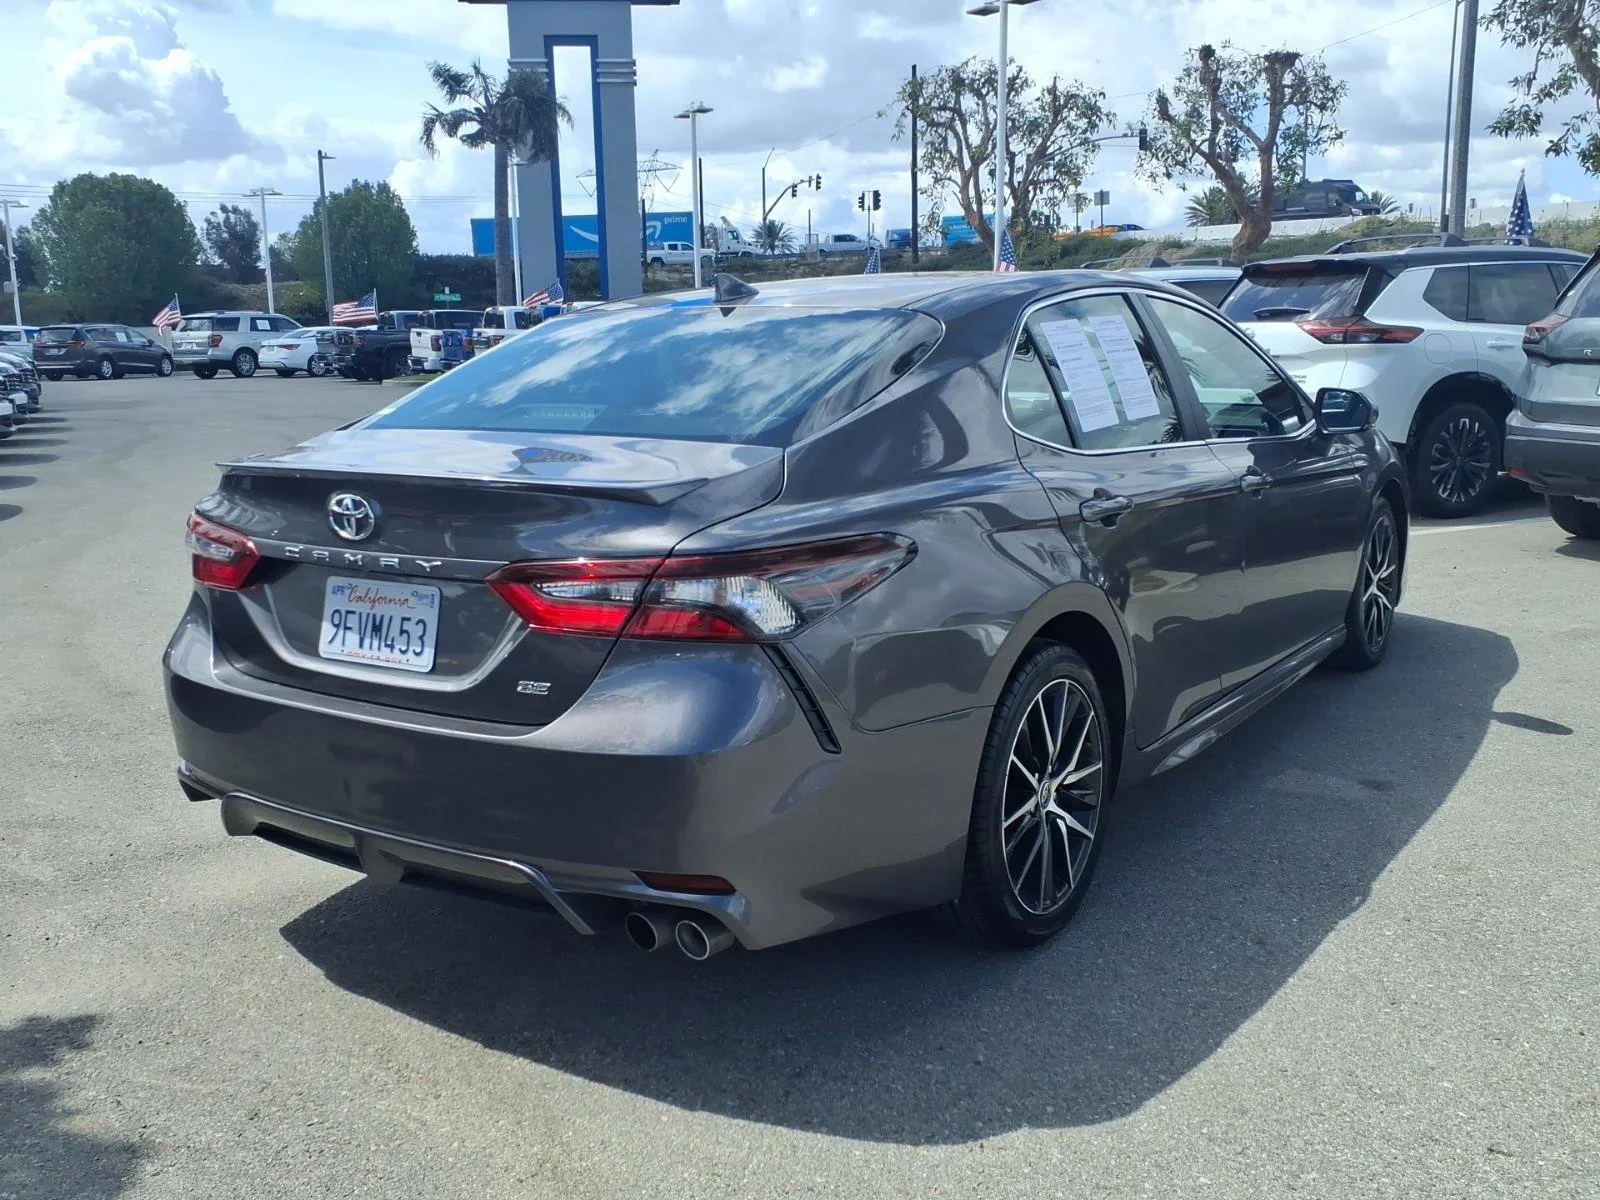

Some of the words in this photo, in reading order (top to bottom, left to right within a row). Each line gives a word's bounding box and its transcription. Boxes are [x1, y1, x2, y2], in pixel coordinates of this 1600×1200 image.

[664, 216, 688, 224] prime
[284, 546, 442, 571] CAMRY
[347, 584, 416, 610] California
[328, 608, 427, 656] 9FVM453
